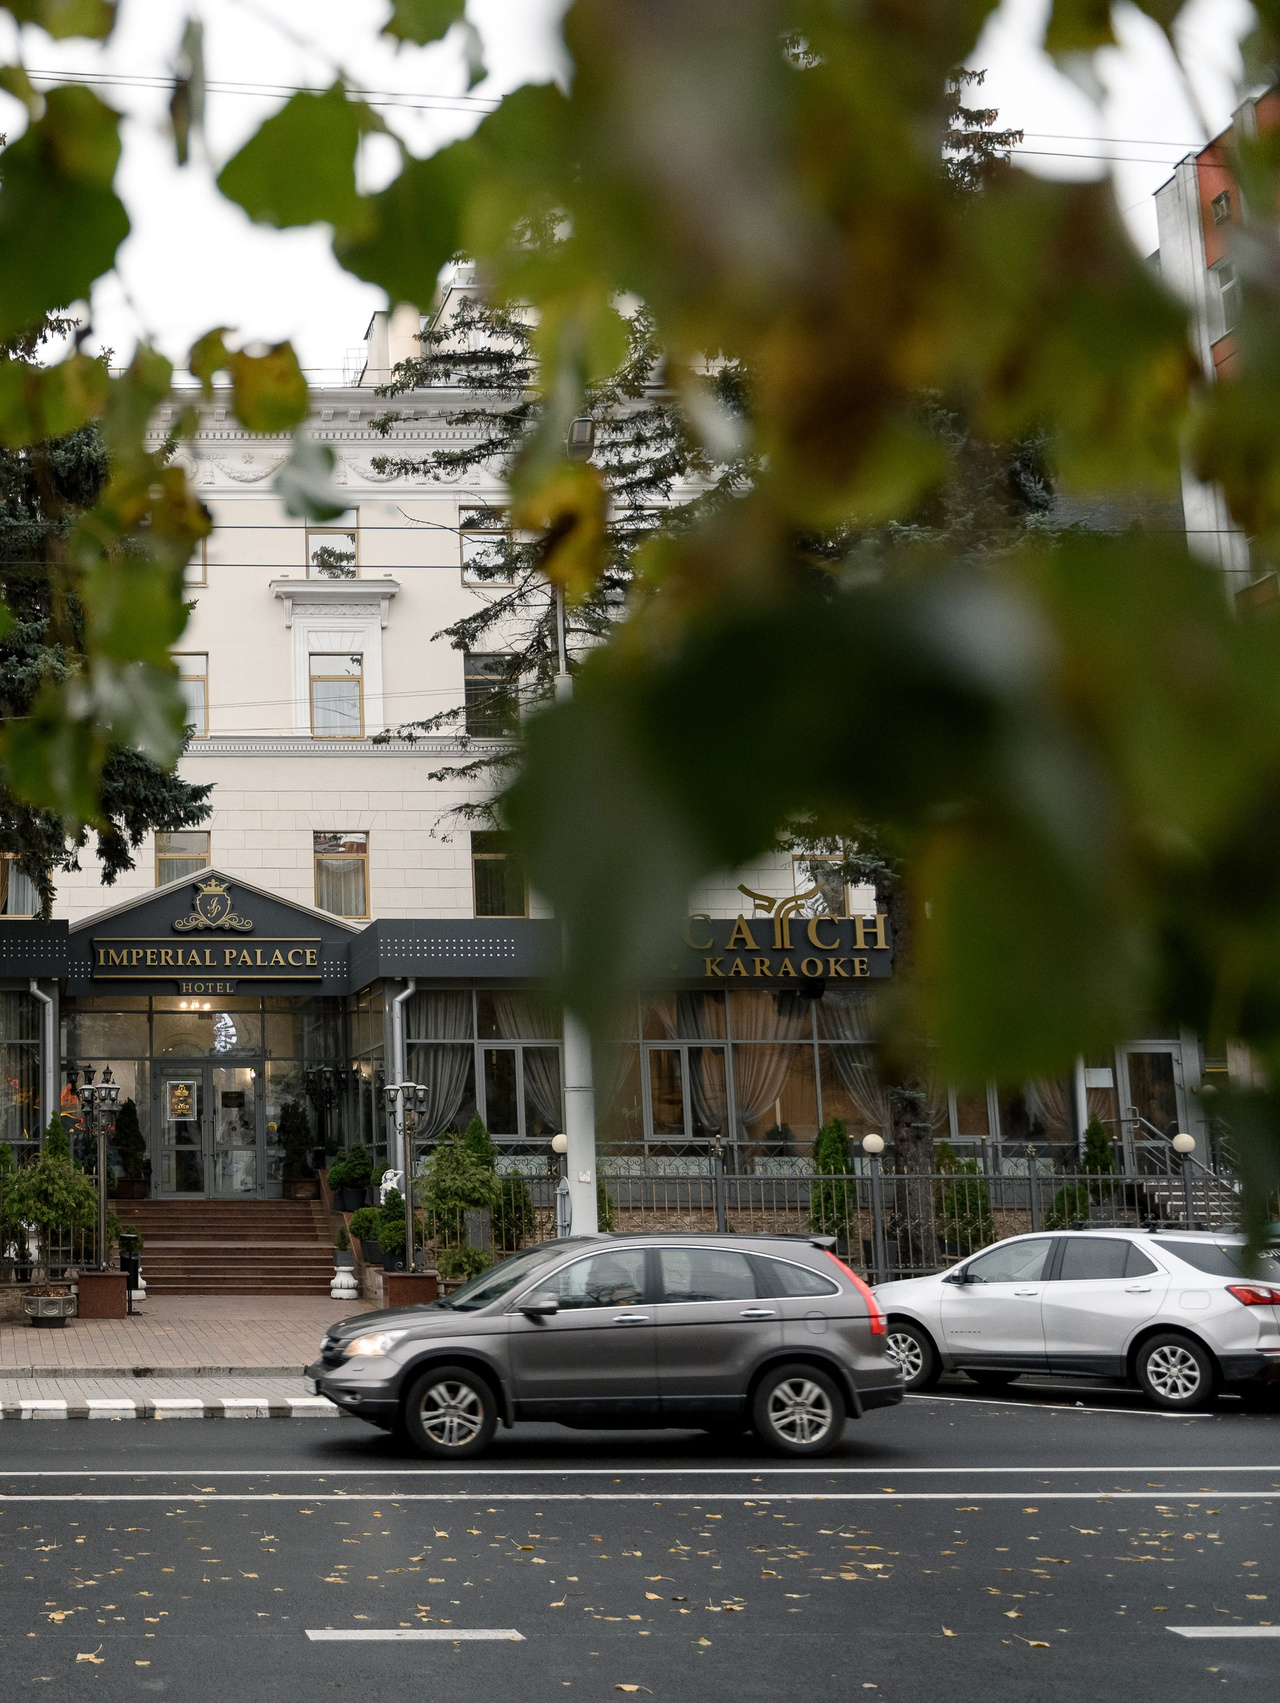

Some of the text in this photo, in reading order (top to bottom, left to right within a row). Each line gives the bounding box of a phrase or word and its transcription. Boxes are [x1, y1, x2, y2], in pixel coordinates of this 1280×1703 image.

[98, 949, 318, 966] IMPERIAL PALACE
[703, 957, 870, 977] KARAOKE
[182, 983, 234, 993] HOTEL
